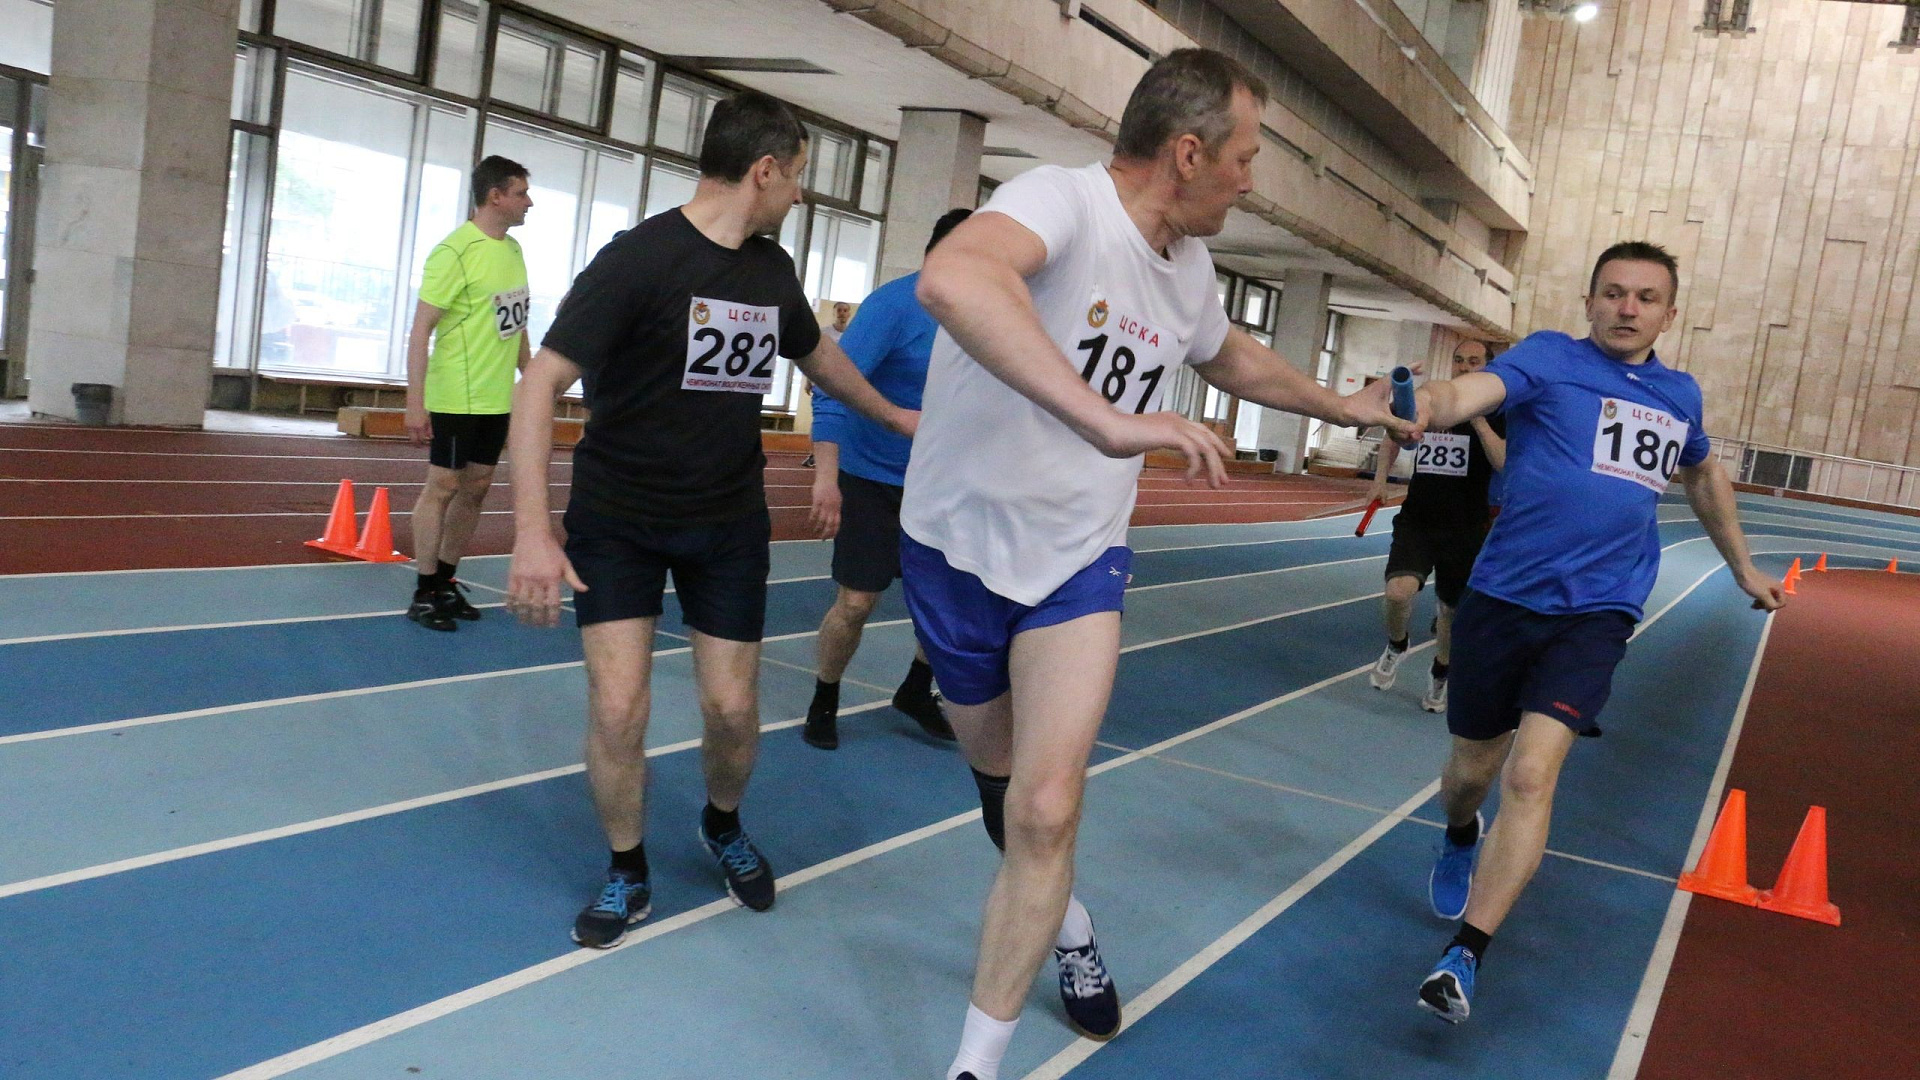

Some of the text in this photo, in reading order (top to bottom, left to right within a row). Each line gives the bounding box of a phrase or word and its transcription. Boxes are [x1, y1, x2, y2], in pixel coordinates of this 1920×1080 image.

[728, 309, 767, 322] ЦСКА
[1119, 315, 1160, 348] ЦСКА
[687, 327, 776, 378] 282
[1077, 333, 1165, 415] 181
[1632, 408, 1673, 429] ЦСКА
[1417, 444, 1467, 469] 283
[1602, 422, 1680, 481] 180
